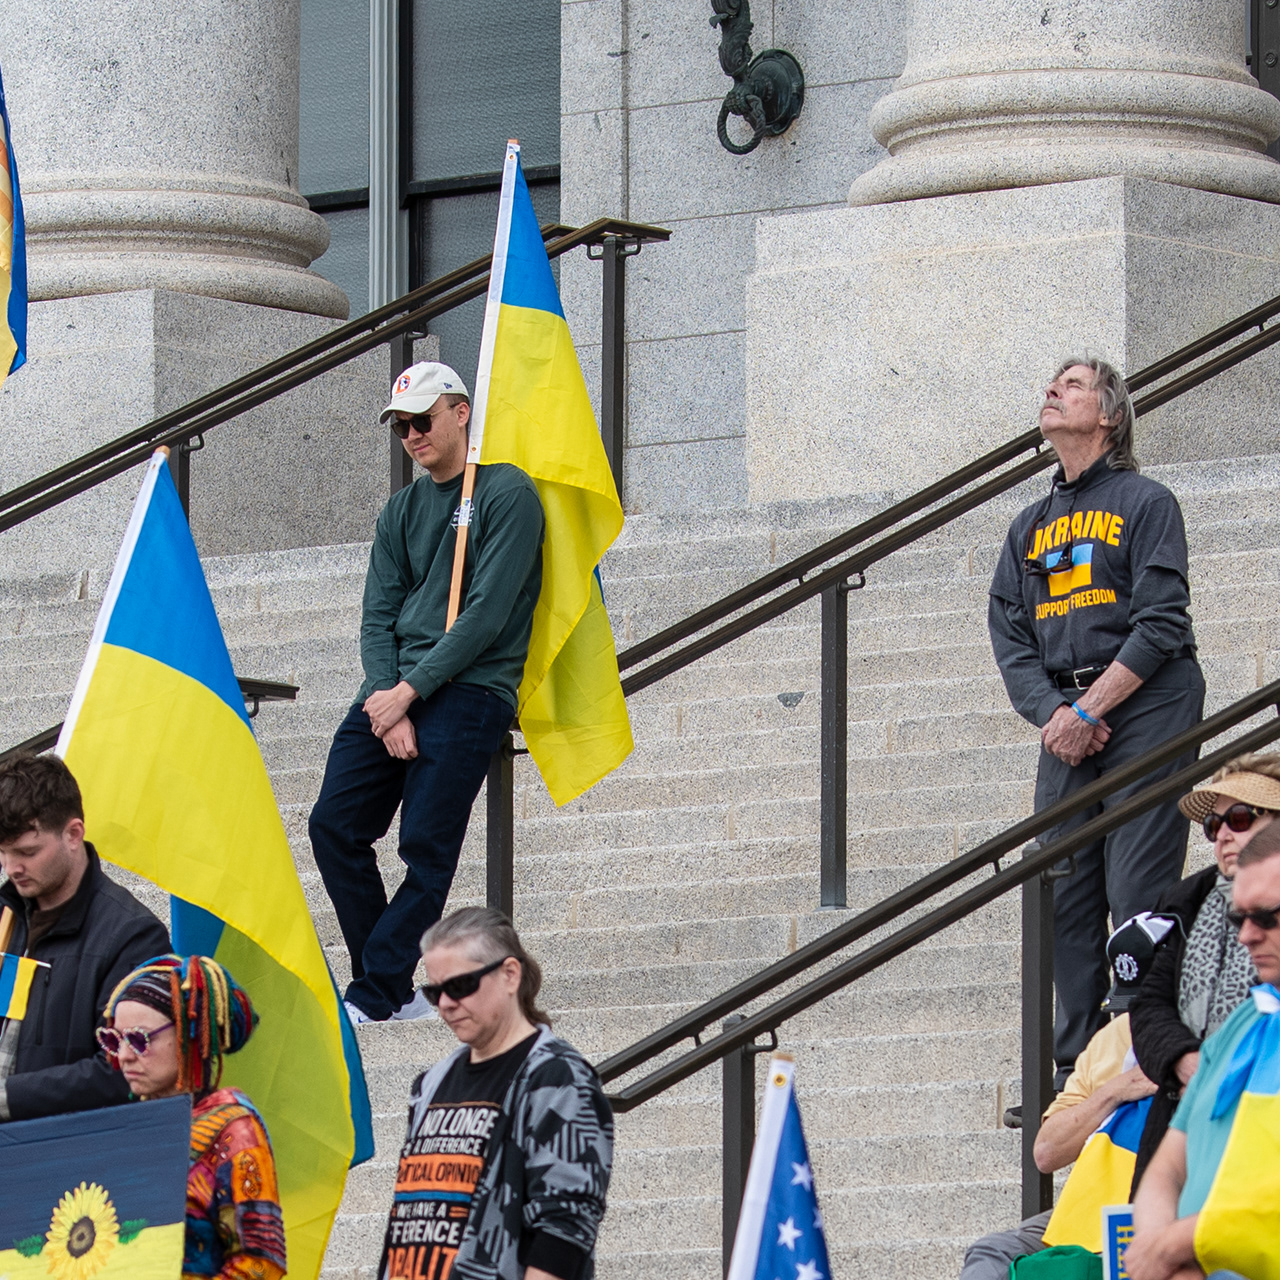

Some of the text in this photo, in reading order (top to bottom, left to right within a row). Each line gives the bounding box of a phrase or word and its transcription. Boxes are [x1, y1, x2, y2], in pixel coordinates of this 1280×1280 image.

[1027, 511, 1124, 560] UKRAINE
[1036, 589, 1117, 620] SUPPOR FREEDOM
[419, 1107, 499, 1140] NO LONGE
[421, 1137, 483, 1155] DIFFERENCE
[435, 1161, 480, 1185] OPINIO
[412, 1201, 436, 1218] HAVE
[435, 1202, 447, 1218] A
[390, 1219, 461, 1245] FERENCE
